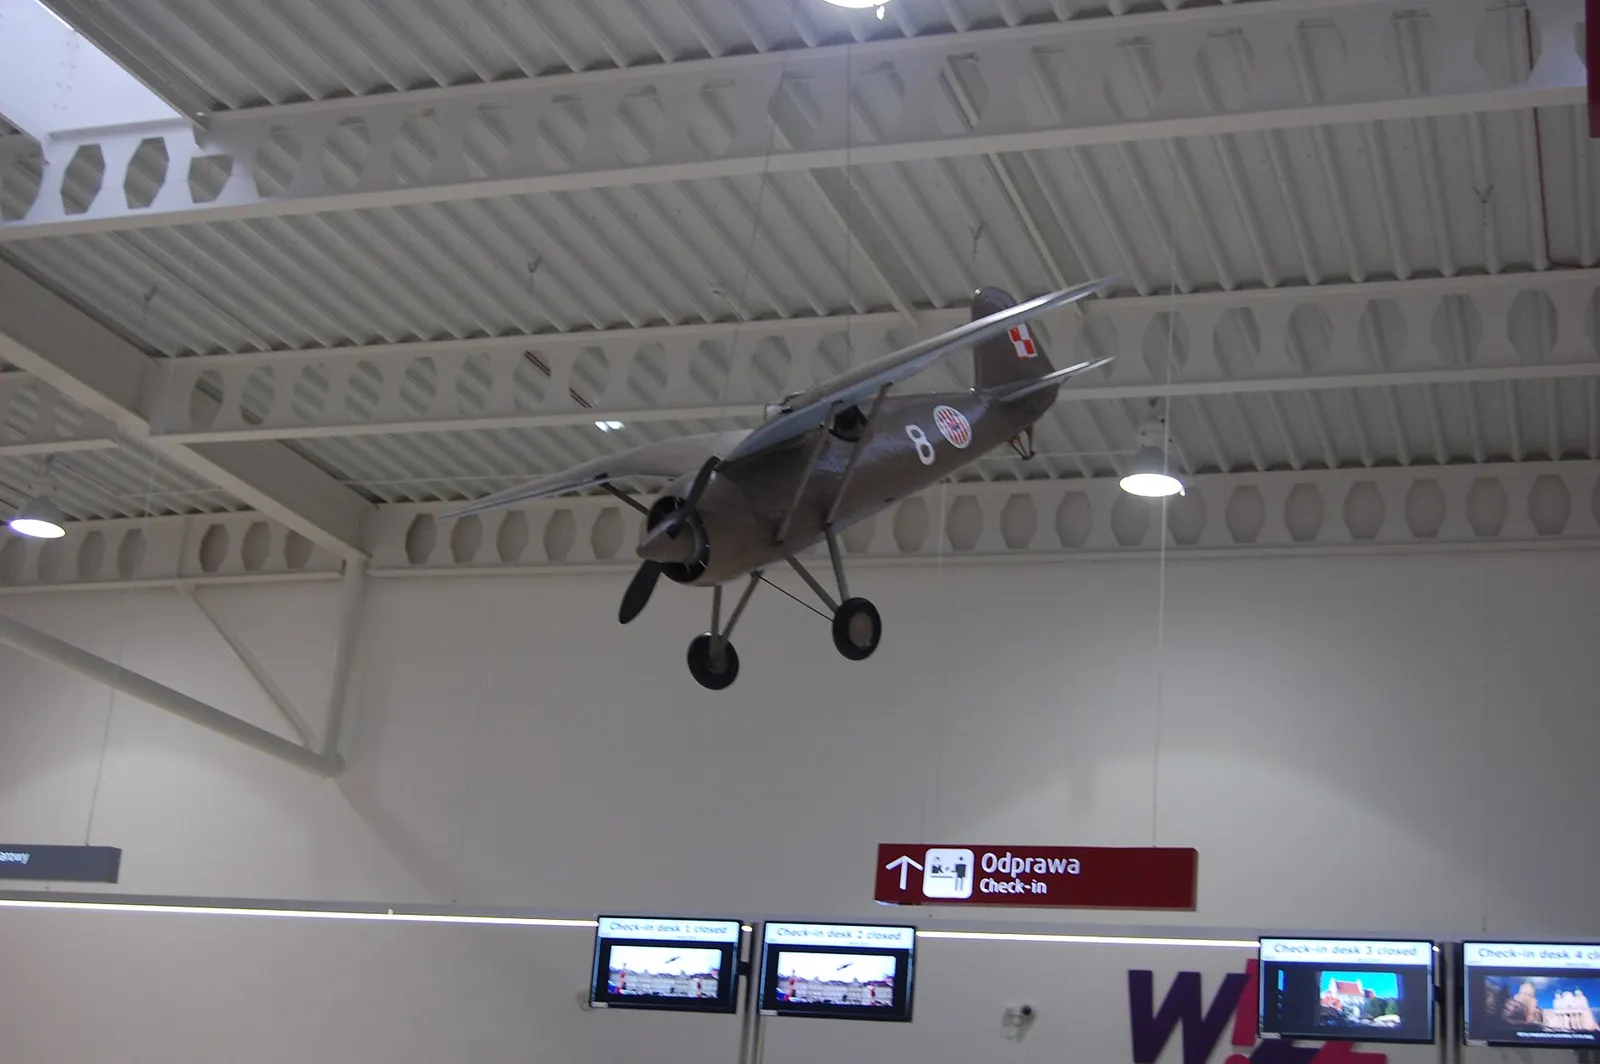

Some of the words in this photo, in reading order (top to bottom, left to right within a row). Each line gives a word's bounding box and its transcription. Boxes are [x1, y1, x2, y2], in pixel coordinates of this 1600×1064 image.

[904, 424, 936, 466] 8
[981, 851, 1081, 878] Odprawa
[979, 877, 1048, 894] Check-in
[609, 921, 654, 932] Check-in
[657, 923, 681, 933] desk
[693, 925, 728, 934] closed
[776, 927, 824, 937] Check-in
[827, 929, 853, 939] desk
[857, 929, 864, 939] 2
[866, 930, 902, 940] closed
[1273, 943, 1328, 953] Check-in
[1331, 945, 1361, 955] desk
[1365, 946, 1373, 955] 3
[1376, 946, 1417, 956] closed
[1477, 947, 1536, 958] Check-in
[1538, 949, 1570, 960] desk
[1574, 950, 1583, 959] 4
